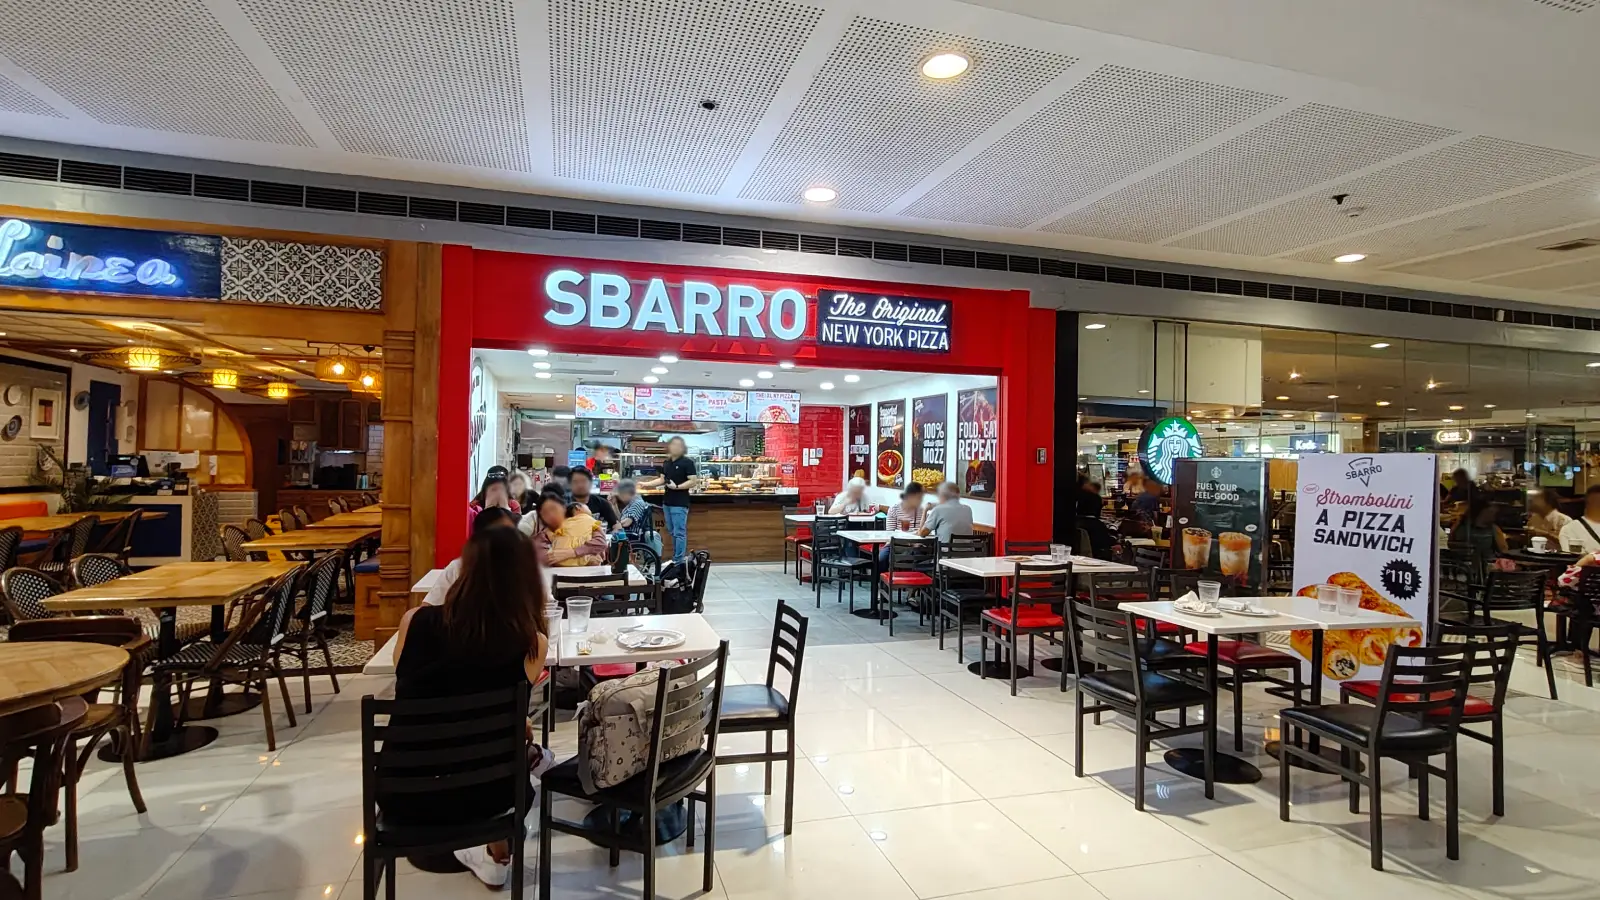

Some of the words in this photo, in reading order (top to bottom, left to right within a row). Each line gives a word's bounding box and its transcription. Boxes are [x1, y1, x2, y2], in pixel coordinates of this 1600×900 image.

[543, 268, 807, 341] SBARRO
[830, 293, 866, 316] The
[872, 297, 947, 326] Original
[822, 322, 859, 344] NEW
[863, 325, 904, 347] YORK
[908, 329, 949, 351] PIZZA
[923, 422, 945, 439] 100%
[958, 421, 982, 438] FOLD.
[922, 448, 944, 464] MOZZ
[958, 438, 997, 462] REPEAT
[1345, 464, 1383, 480] SBARRO
[1194, 491, 1240, 501] FEEL-GOOD
[1196, 482, 1214, 491] FUEL
[1214, 483, 1238, 492] YOUR
[1316, 488, 1414, 510] Strombolini
[1315, 508, 1329, 526] A
[1341, 510, 1405, 533] PIZZA
[1313, 528, 1414, 554] SANDWICH
